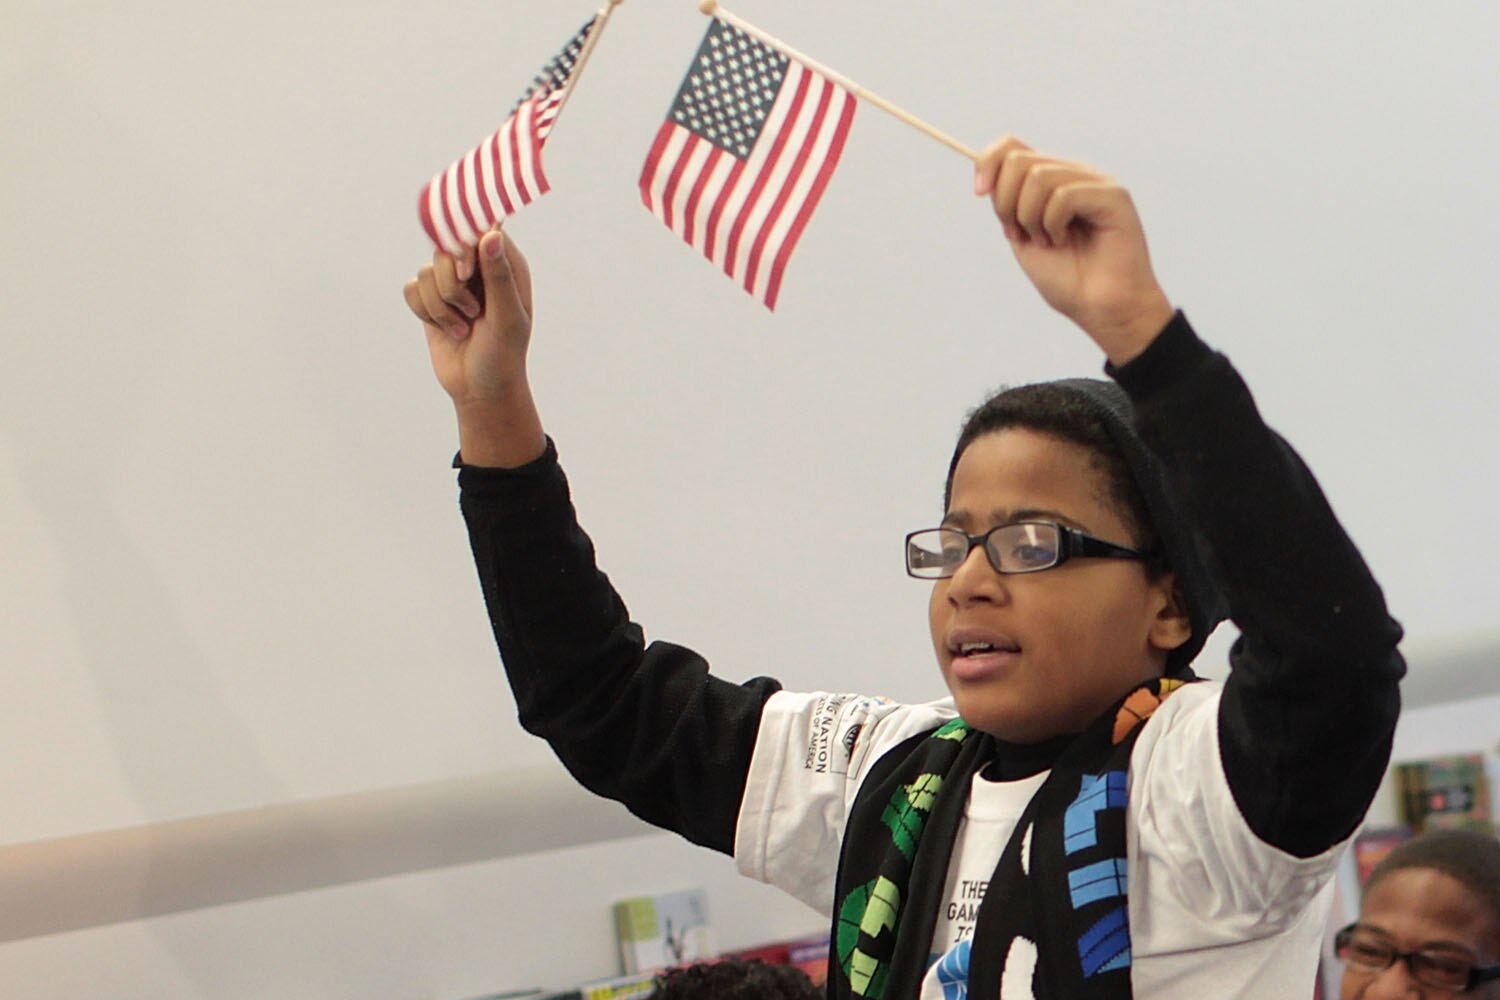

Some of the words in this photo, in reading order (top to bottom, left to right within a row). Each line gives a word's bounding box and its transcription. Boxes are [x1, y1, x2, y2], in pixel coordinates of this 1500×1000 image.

[804, 732, 819, 769] AMERICA
[815, 716, 833, 774] NATION
[961, 880, 990, 899] THE
[947, 902, 980, 921] GAM
